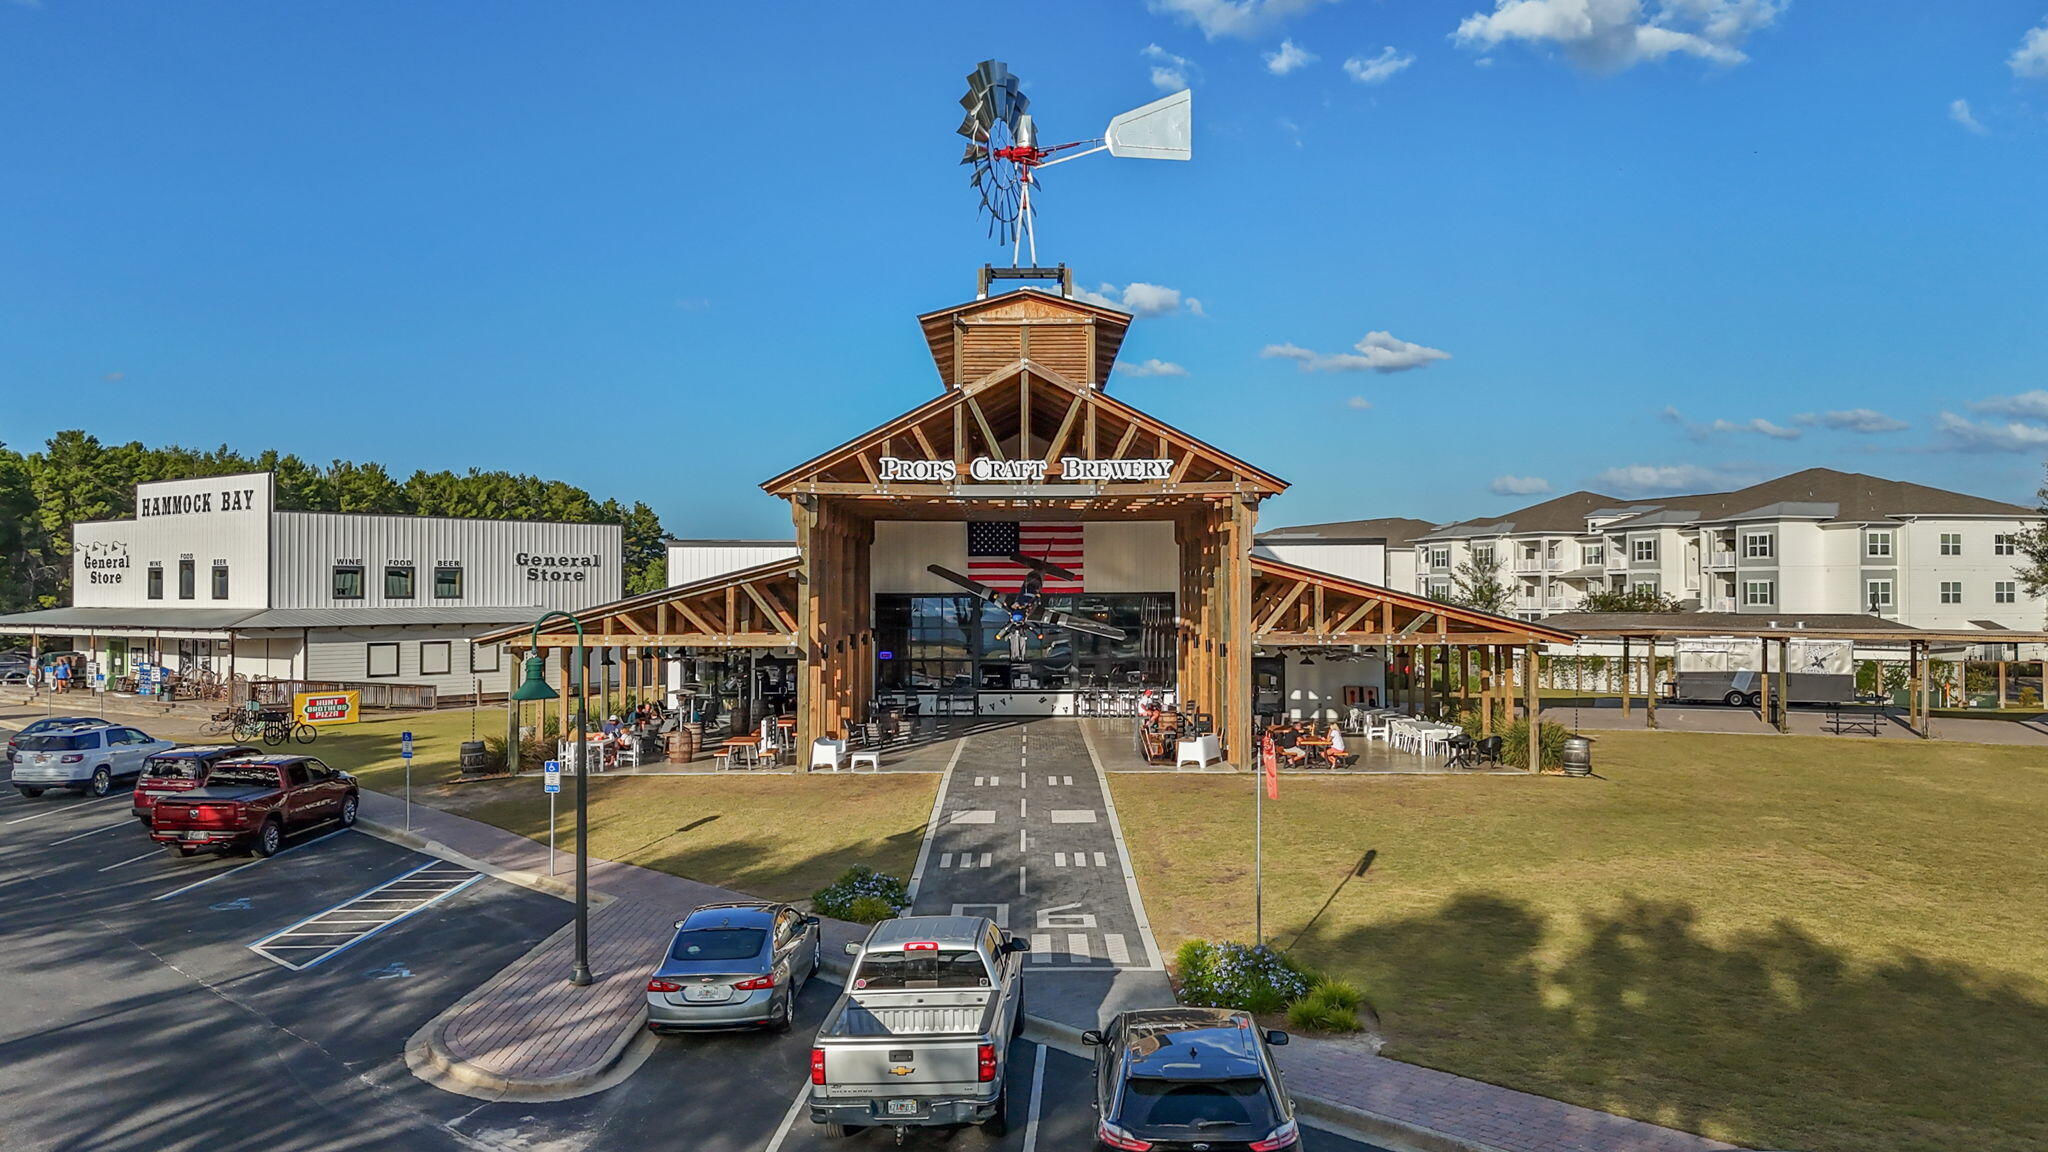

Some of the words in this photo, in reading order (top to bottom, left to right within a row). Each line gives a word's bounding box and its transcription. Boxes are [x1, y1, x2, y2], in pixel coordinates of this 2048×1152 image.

[879, 459, 955, 480] PROPS
[971, 459, 1046, 480] CRAFT
[1062, 459, 1173, 479] BREWERY
[141, 493, 212, 517] HAMMOCK
[221, 490, 254, 511] BAY
[84, 555, 130, 569] General
[336, 558, 361, 566] WINE
[515, 552, 601, 568] General
[90, 571, 122, 584] Store
[526, 568, 585, 582] Store
[307, 704, 347, 713] BROTHERS
[316, 698, 339, 706] HUNT
